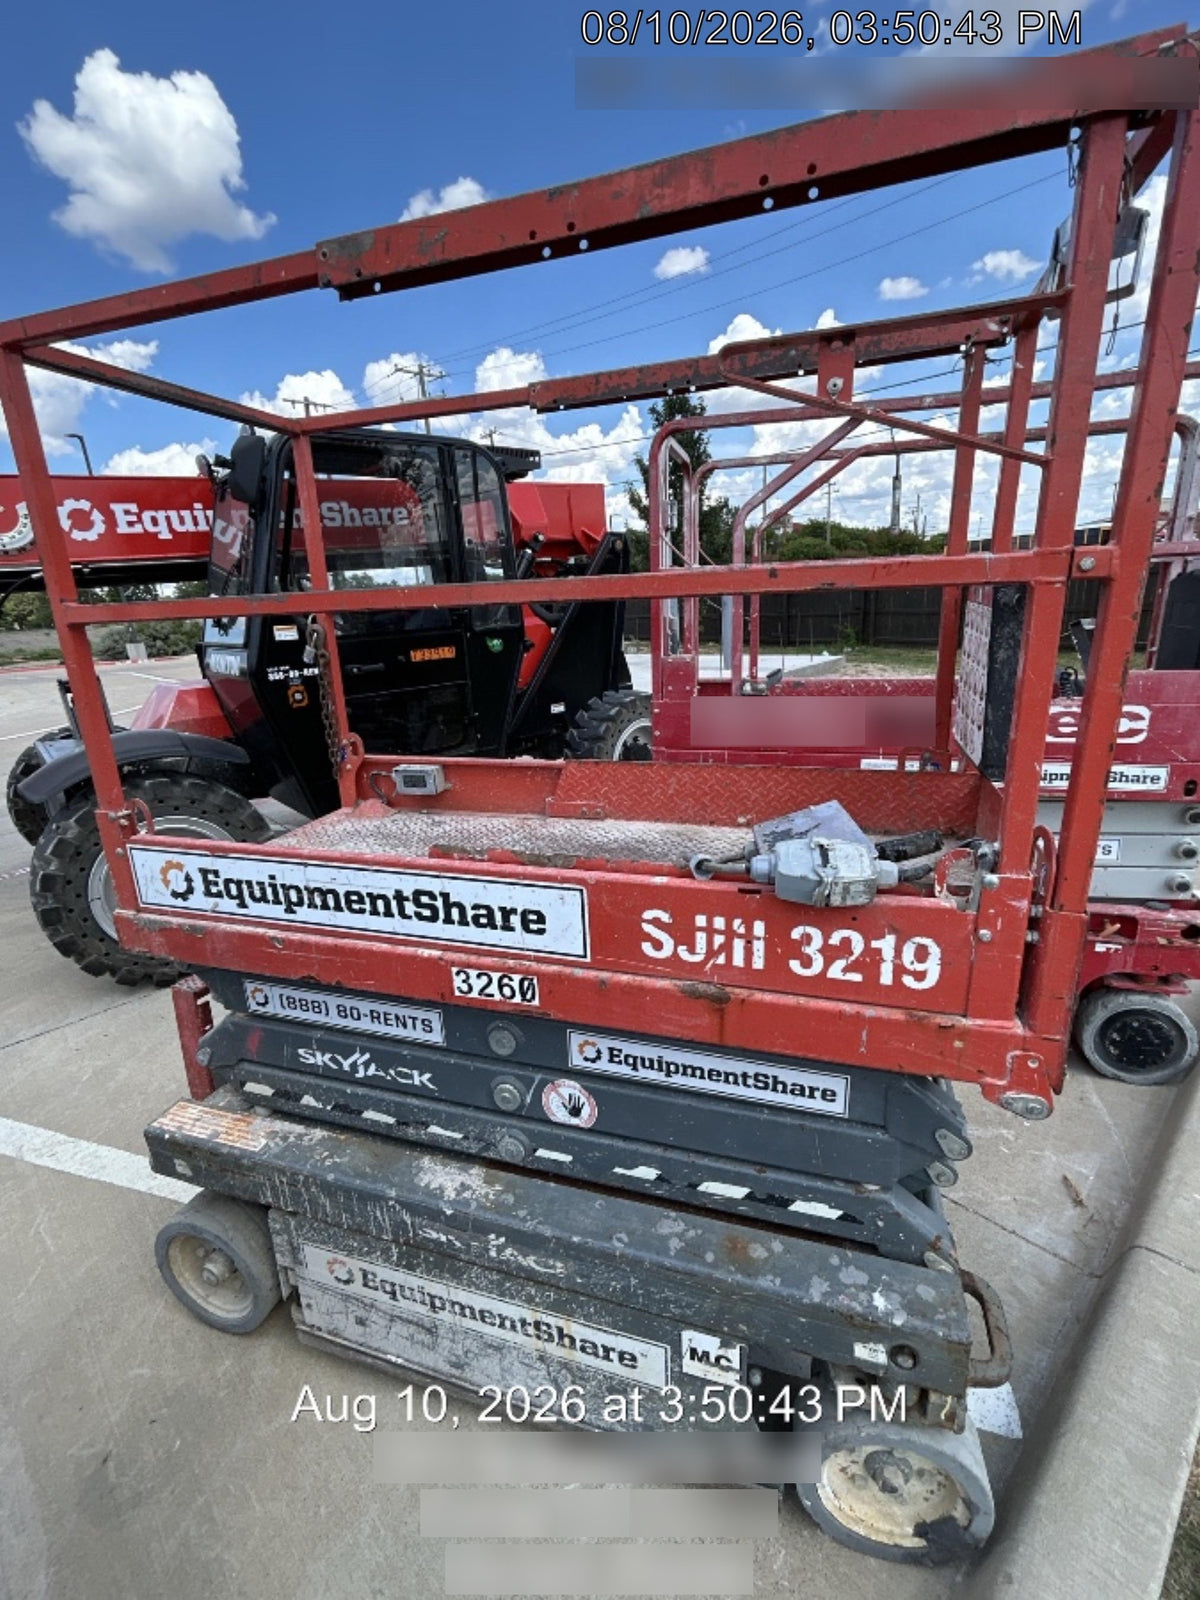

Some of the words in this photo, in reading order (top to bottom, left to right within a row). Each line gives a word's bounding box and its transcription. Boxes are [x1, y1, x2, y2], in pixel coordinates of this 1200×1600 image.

[198, 866, 547, 936] EquipmentShare
[455, 969, 536, 1003] 3260
[788, 925, 942, 990] 3219
[279, 993, 330, 1017] (888)
[336, 1004, 434, 1034] 80-RENTS
[297, 1047, 438, 1090] SKYJACK
[607, 1045, 838, 1103] EquipmentShare
[358, 1266, 640, 1370] EquipmentShare
